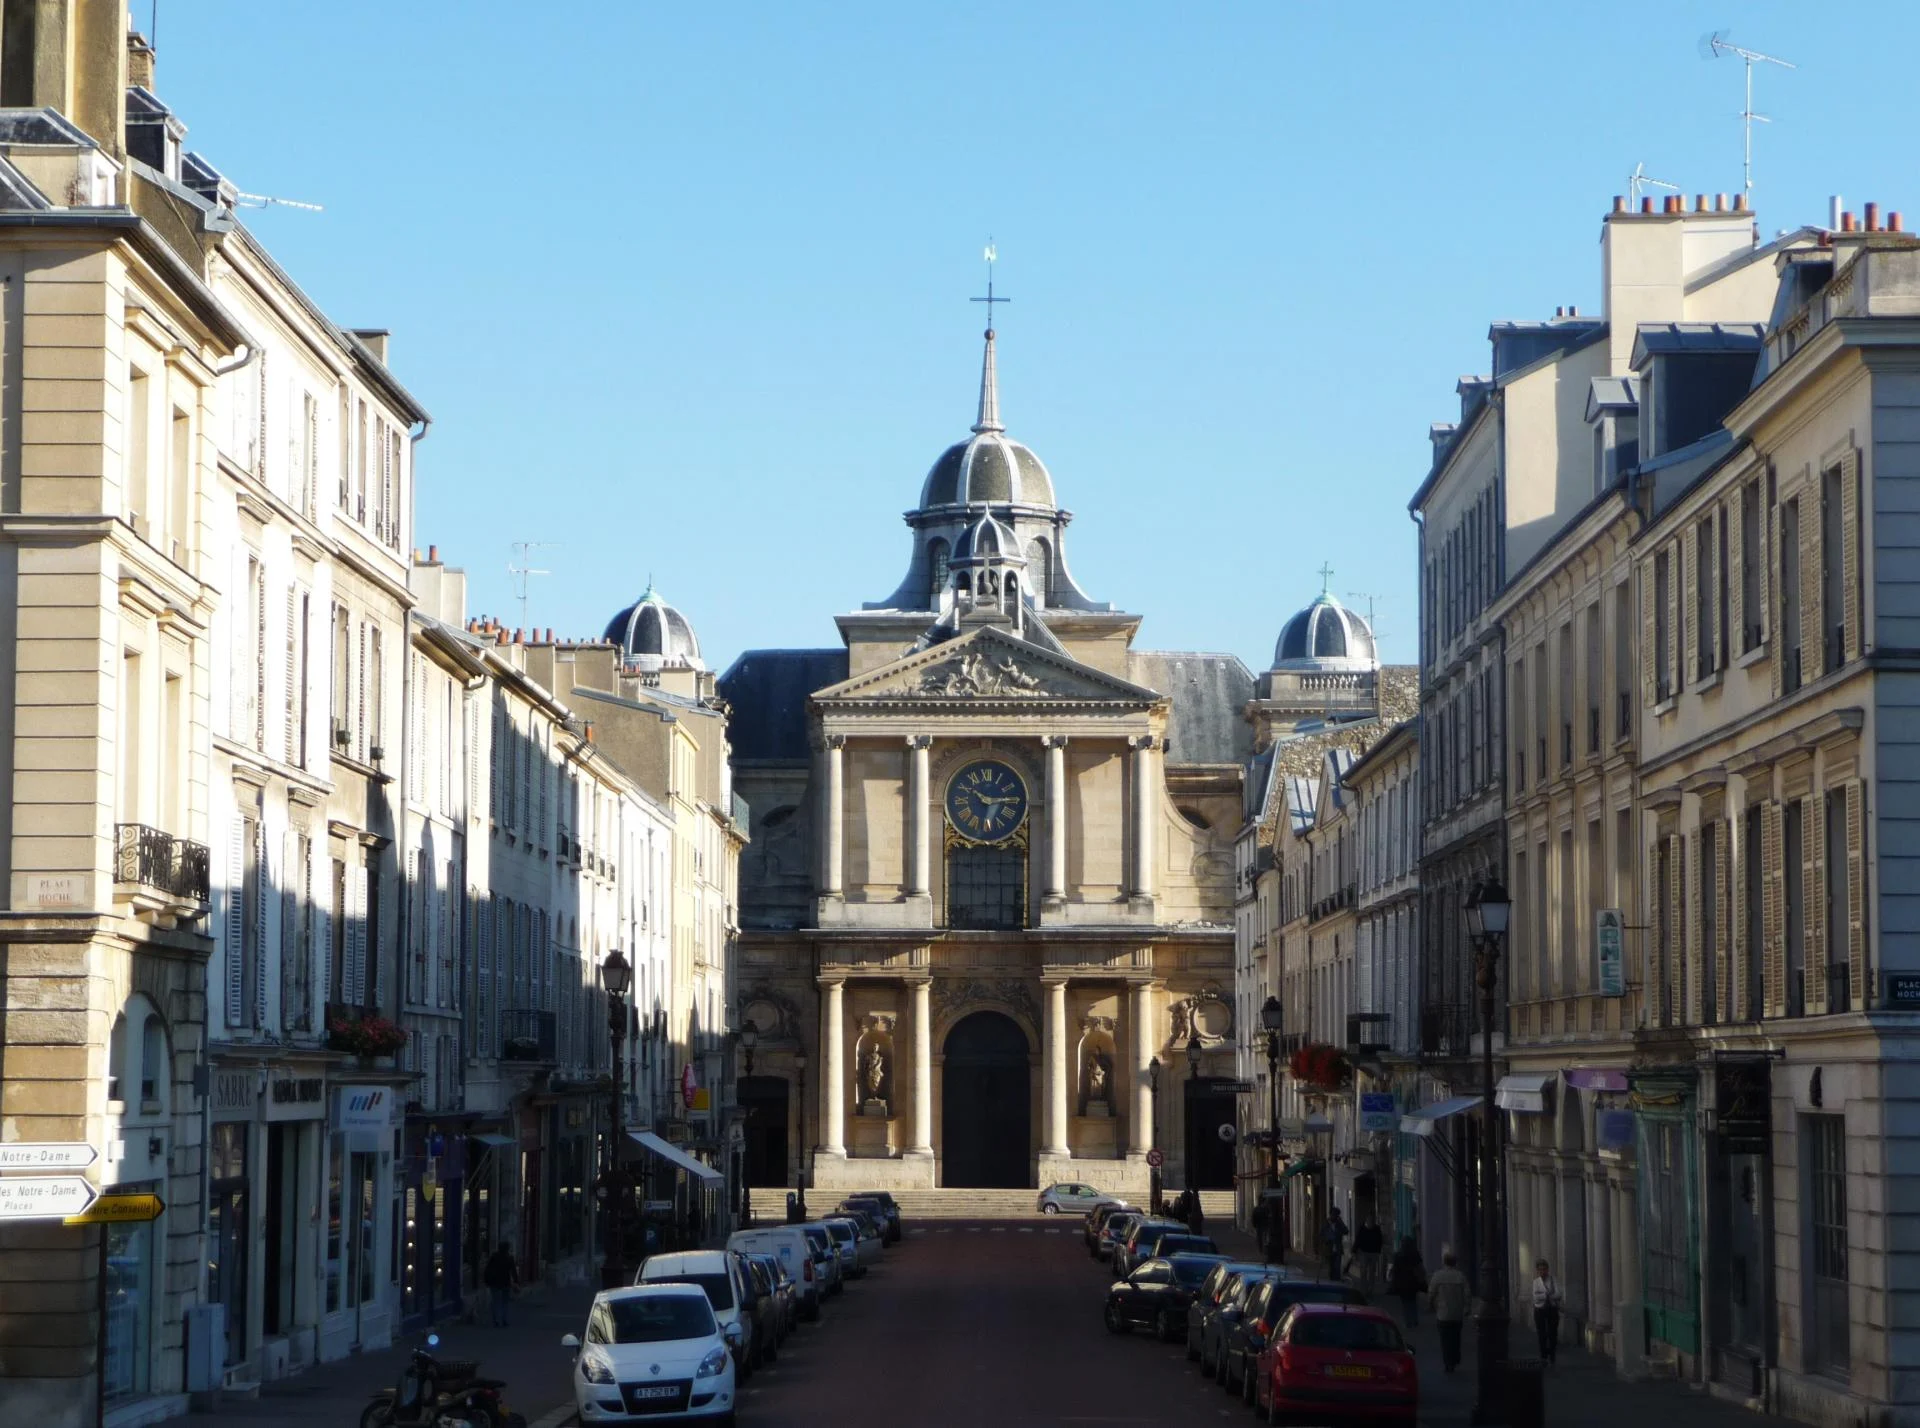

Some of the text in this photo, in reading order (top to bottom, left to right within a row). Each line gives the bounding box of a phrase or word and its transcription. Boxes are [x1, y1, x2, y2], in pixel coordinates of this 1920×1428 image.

[981, 768, 993, 782] XII
[1599, 911, 1621, 996] ARMES
[217, 1074, 252, 1107] SABRE
[4, 1201, 33, 1210] Places
